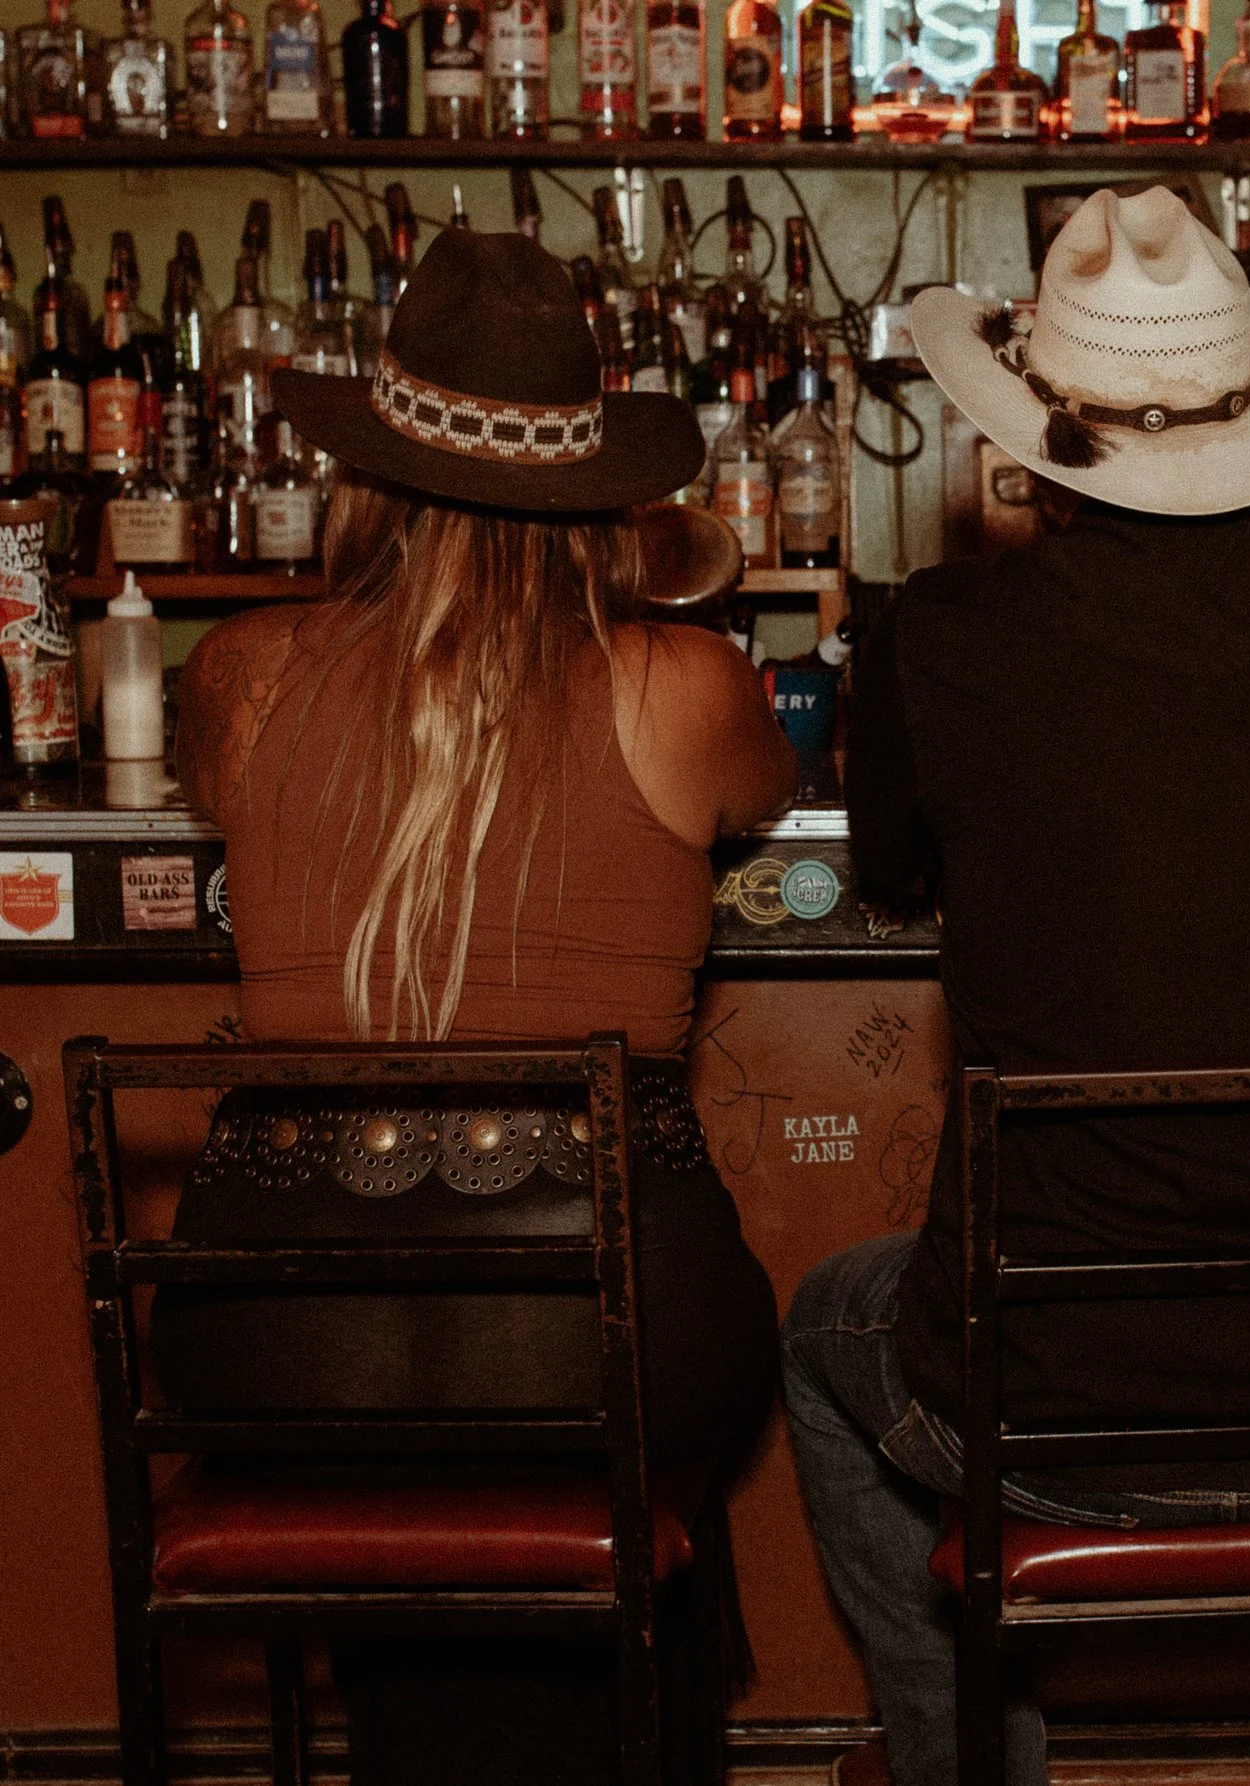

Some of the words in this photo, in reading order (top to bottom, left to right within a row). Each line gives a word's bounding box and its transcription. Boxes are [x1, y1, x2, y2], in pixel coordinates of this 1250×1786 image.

[767, 694, 816, 710] ERY
[127, 873, 158, 886] OLD
[162, 872, 190, 886] ASS
[139, 886, 180, 901] BARS
[866, 1013, 915, 1079] 2024
[783, 1114, 860, 1140] KAYLA
[790, 1140, 855, 1164] JANE
